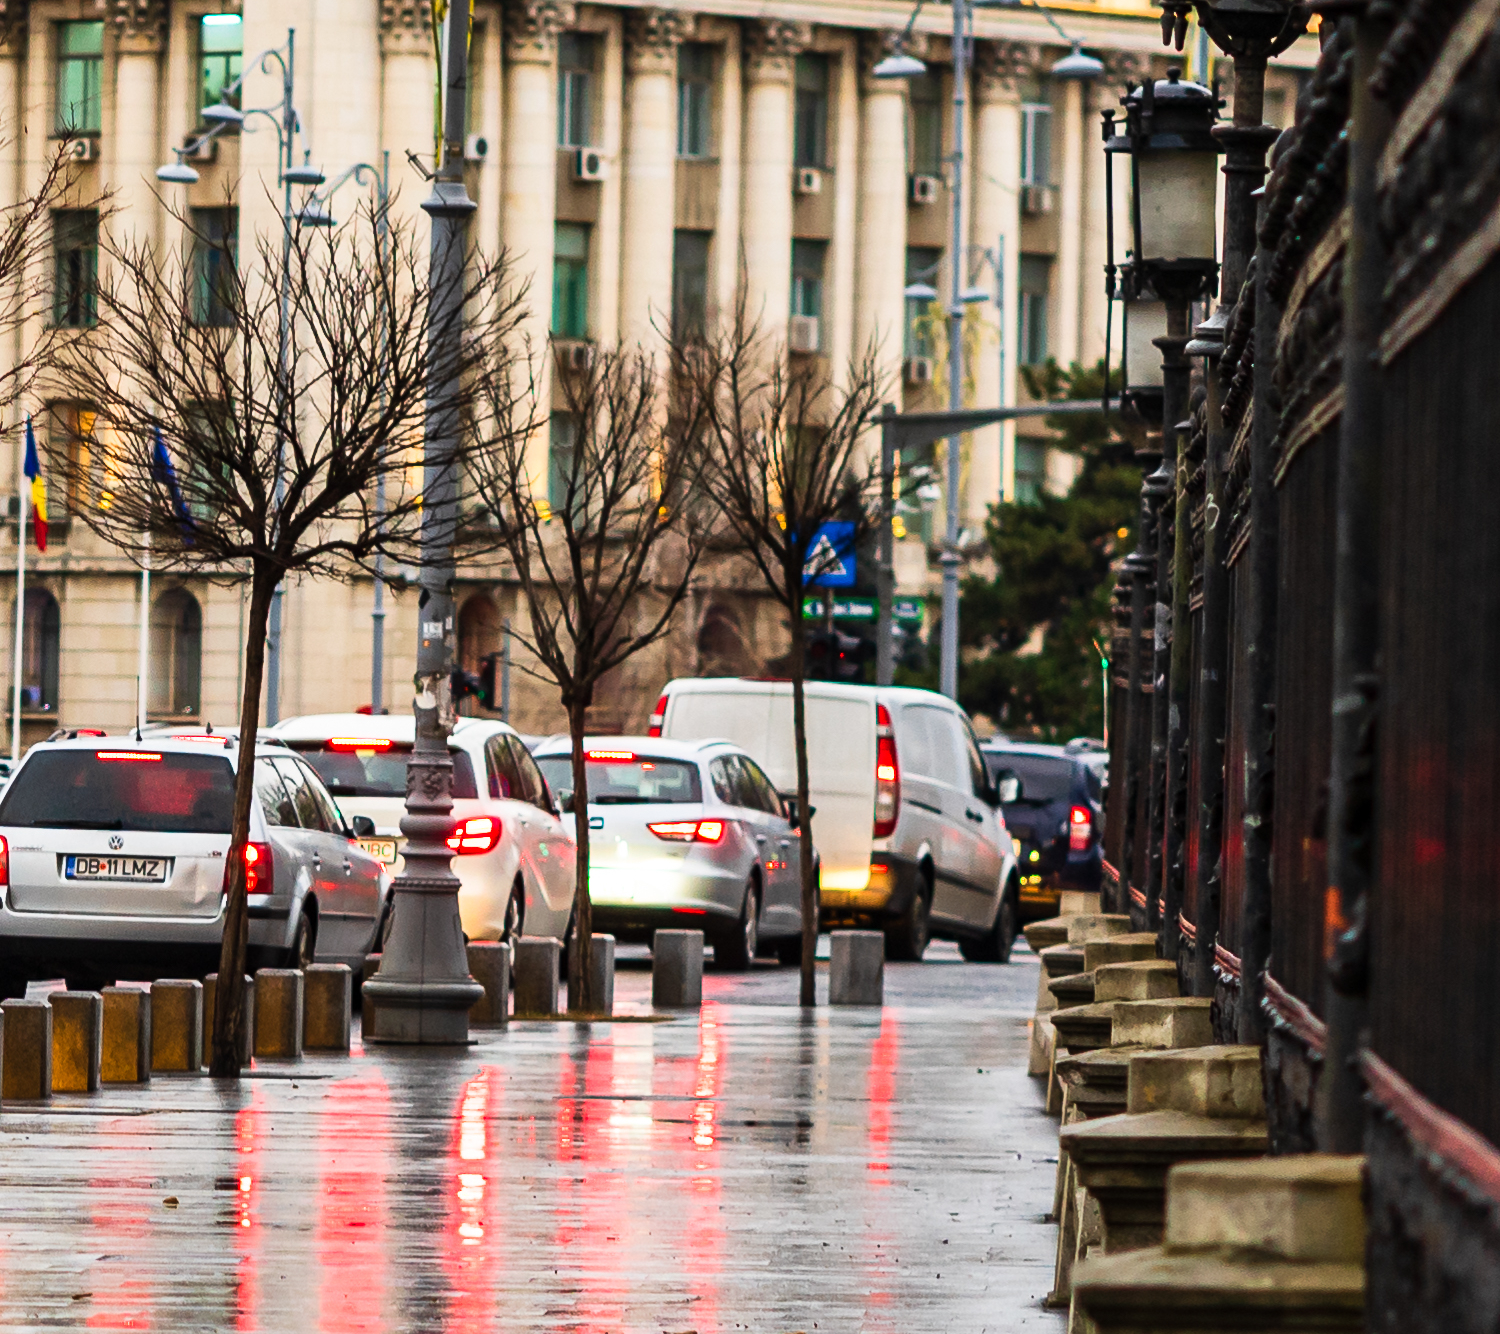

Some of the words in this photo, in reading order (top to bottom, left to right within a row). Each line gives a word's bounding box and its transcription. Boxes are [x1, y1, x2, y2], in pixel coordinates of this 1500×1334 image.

[76, 858, 100, 875] DB
[106, 859, 119, 875] 11
[121, 860, 160, 877] LMZ
